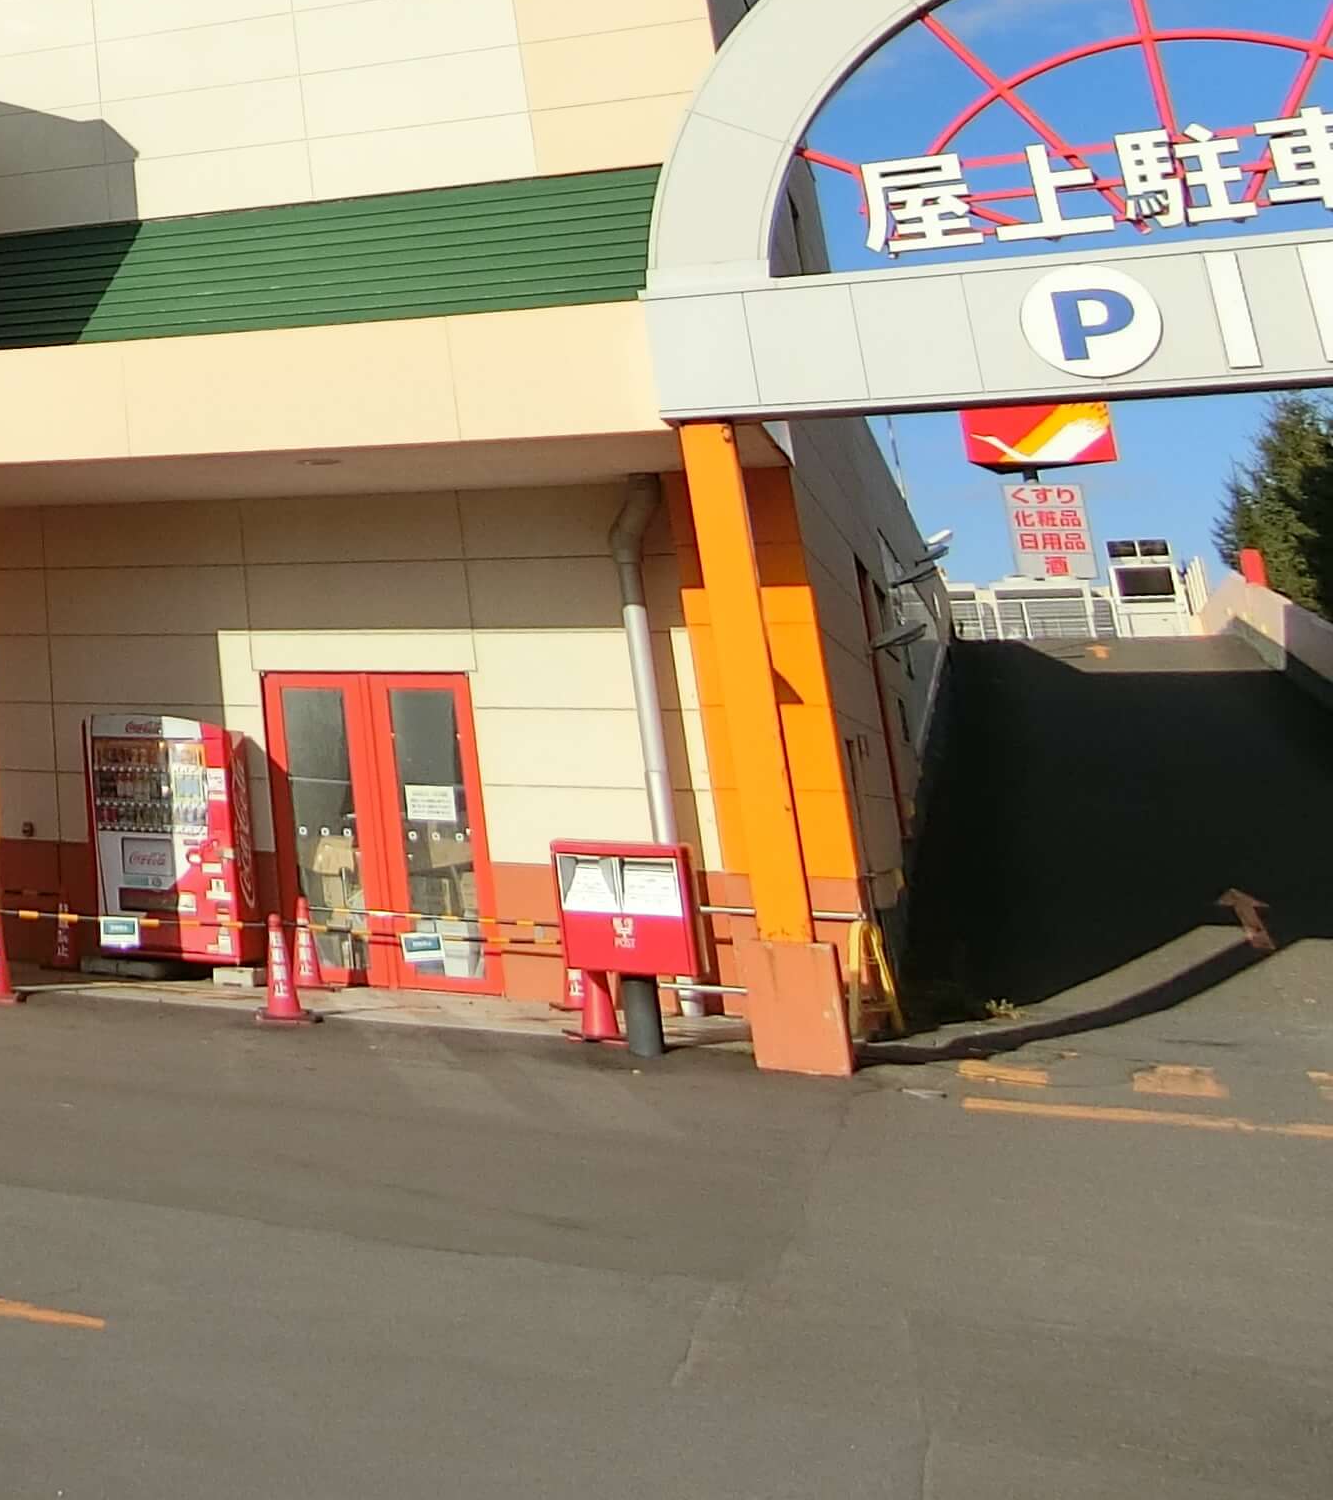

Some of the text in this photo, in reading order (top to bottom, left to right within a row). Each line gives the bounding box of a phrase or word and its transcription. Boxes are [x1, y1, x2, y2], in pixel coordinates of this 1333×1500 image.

[1050, 288, 1135, 362] P
[1011, 487, 1076, 504] くすり
[1014, 509, 1082, 527] 化粧品
[1019, 532, 1086, 550] 日用品
[1044, 555, 1069, 577] 酒
